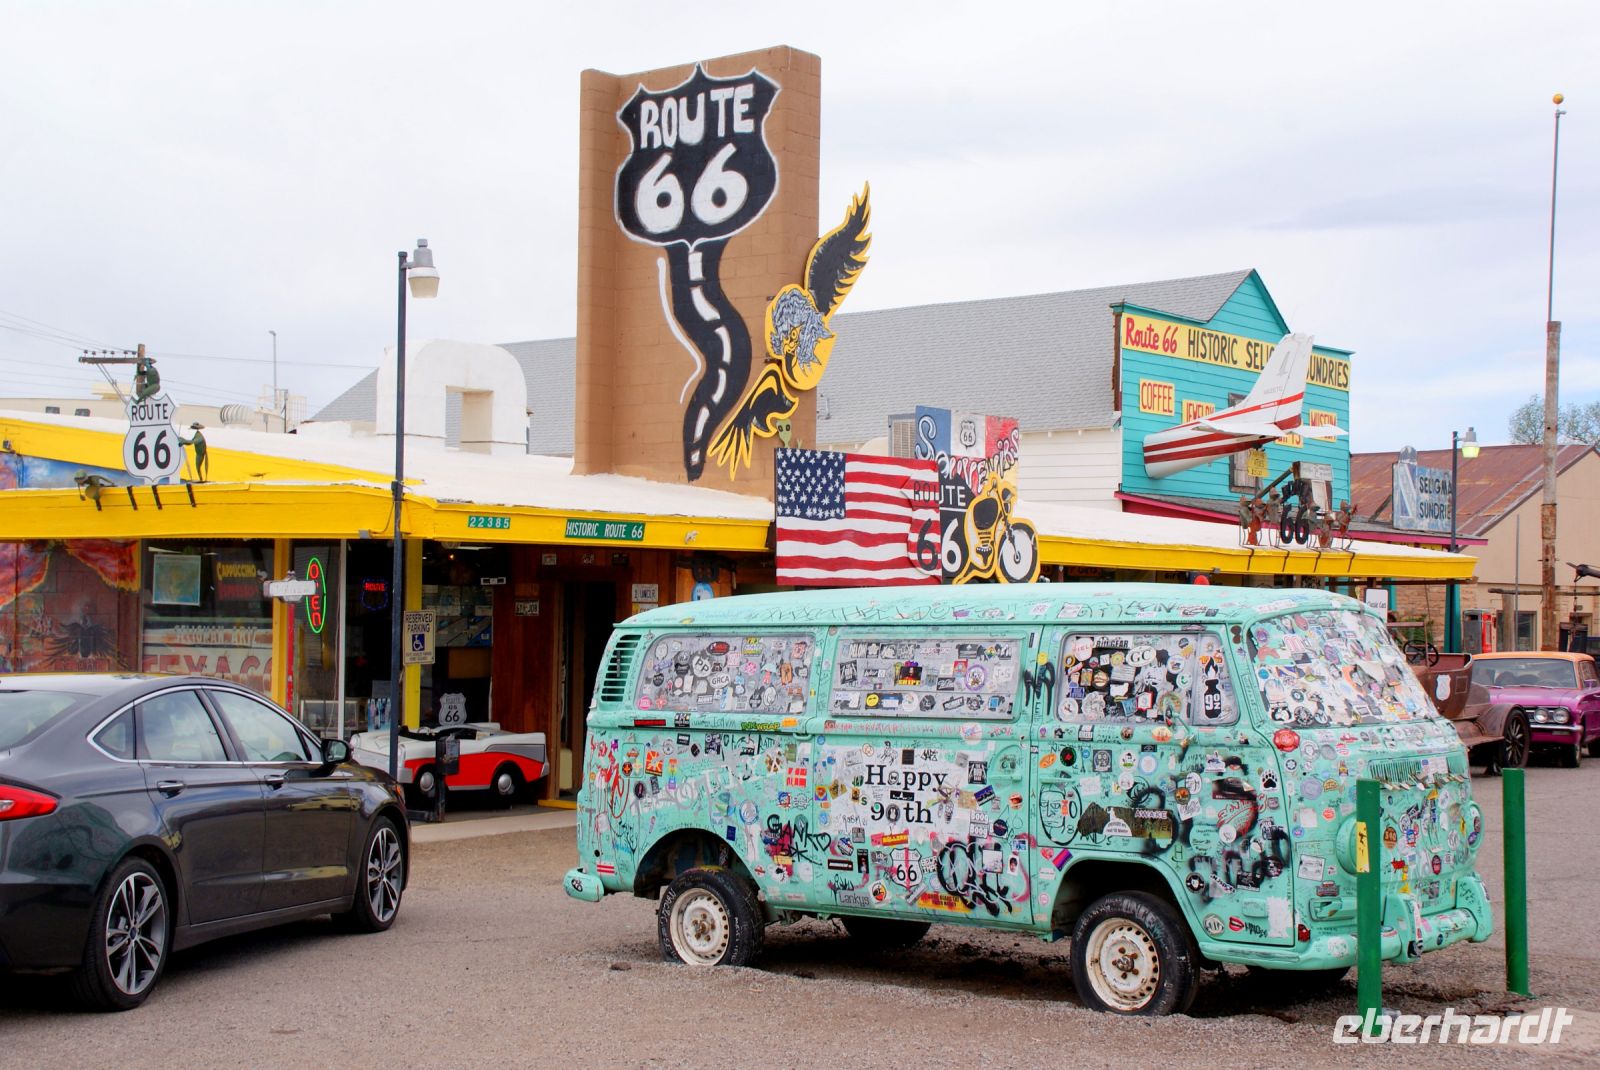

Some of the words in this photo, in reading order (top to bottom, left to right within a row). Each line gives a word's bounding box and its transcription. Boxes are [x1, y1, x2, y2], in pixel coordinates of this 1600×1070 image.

[640, 83, 754, 149] ROUTE
[635, 143, 748, 234] 66
[1125, 318, 1159, 351] Route
[1162, 325, 1178, 354] 66
[1187, 328, 1239, 366] HISTORIC
[1306, 354, 1349, 389] UNDRIES
[1140, 382, 1174, 414] COFFEE
[131, 403, 169, 421] ROUTE
[963, 431, 973, 443] 66
[133, 430, 171, 470] 66
[914, 480, 967, 506] ROUTE
[1419, 476, 1452, 494] SELIGMA
[1419, 502, 1451, 520] SUNDRIE
[469, 516, 510, 528] 22385
[565, 521, 599, 536] HISTORIC
[604, 523, 626, 538] ROUTE
[631, 525, 643, 539] 66
[917, 518, 960, 573] 66
[405, 613, 433, 623] RESERVED
[407, 623, 431, 633] PARKING
[445, 710, 460, 722] 66
[1135, 809, 1169, 820] AWAKE
[896, 864, 917, 882] 66
